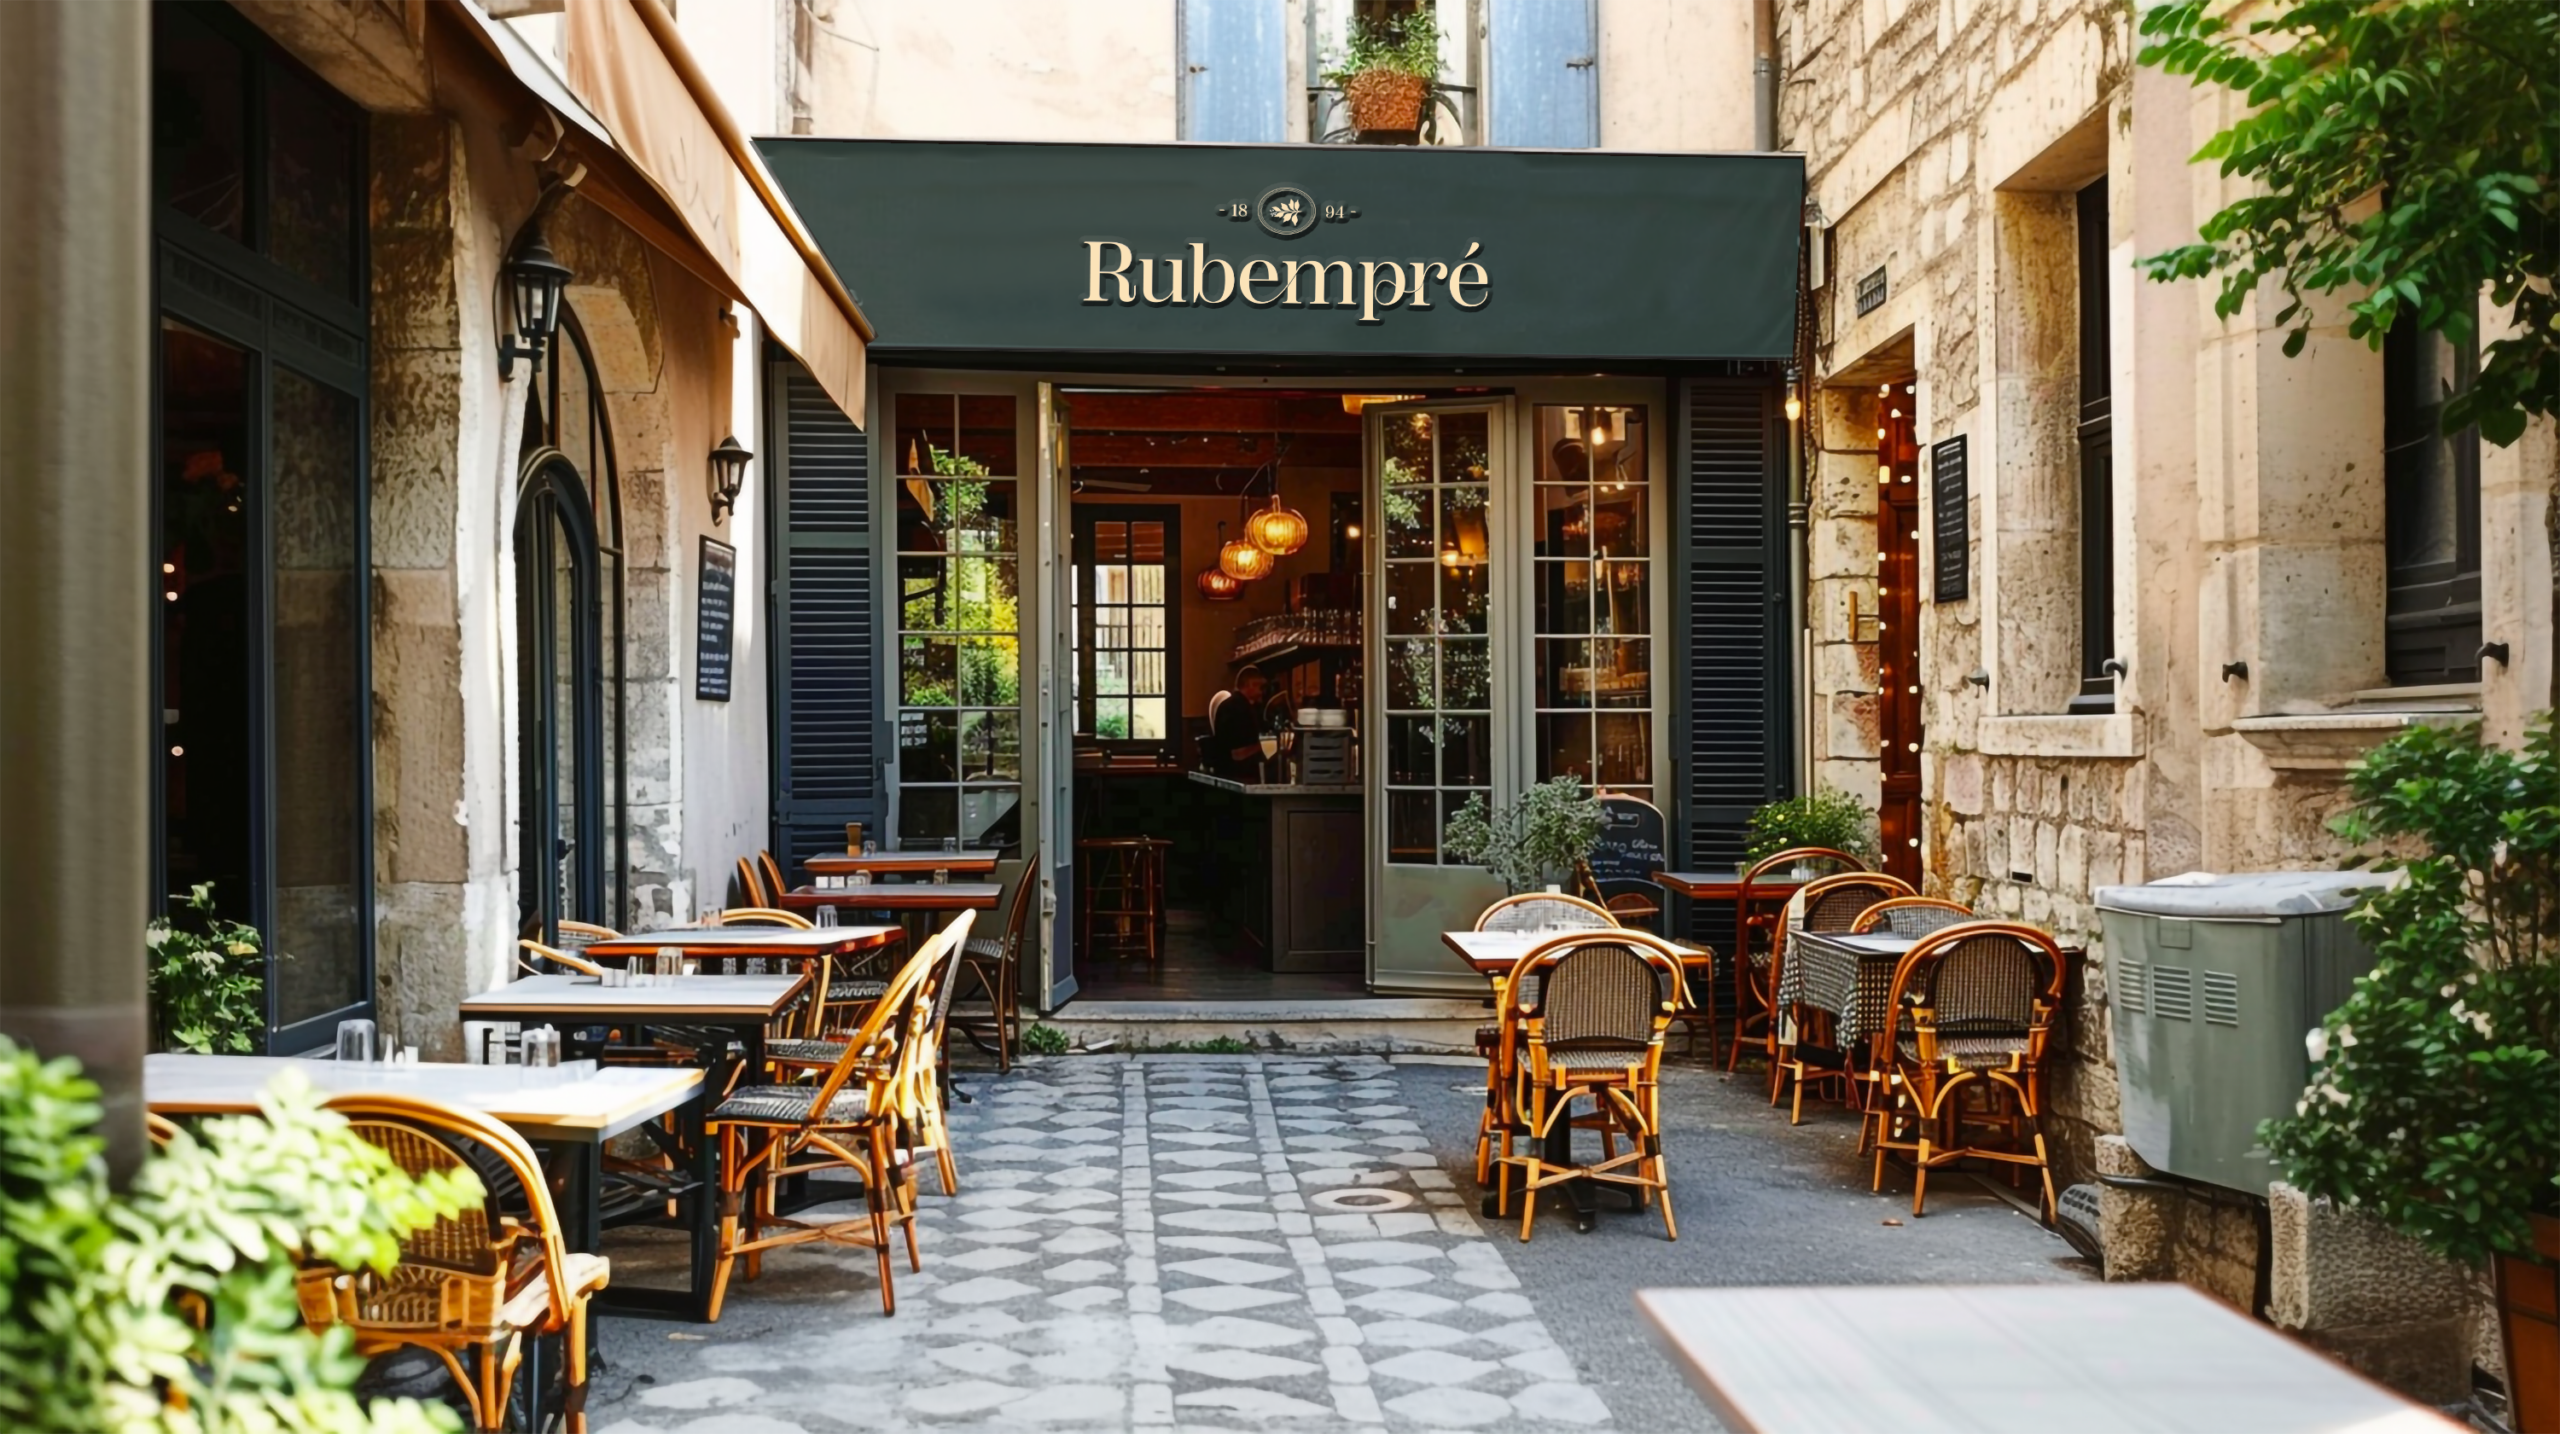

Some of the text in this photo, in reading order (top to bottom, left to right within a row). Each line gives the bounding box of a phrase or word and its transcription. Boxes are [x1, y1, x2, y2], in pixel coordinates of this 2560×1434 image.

[1231, 203, 1344, 219] 18 94
[1083, 241, 1489, 321] Rubempré
